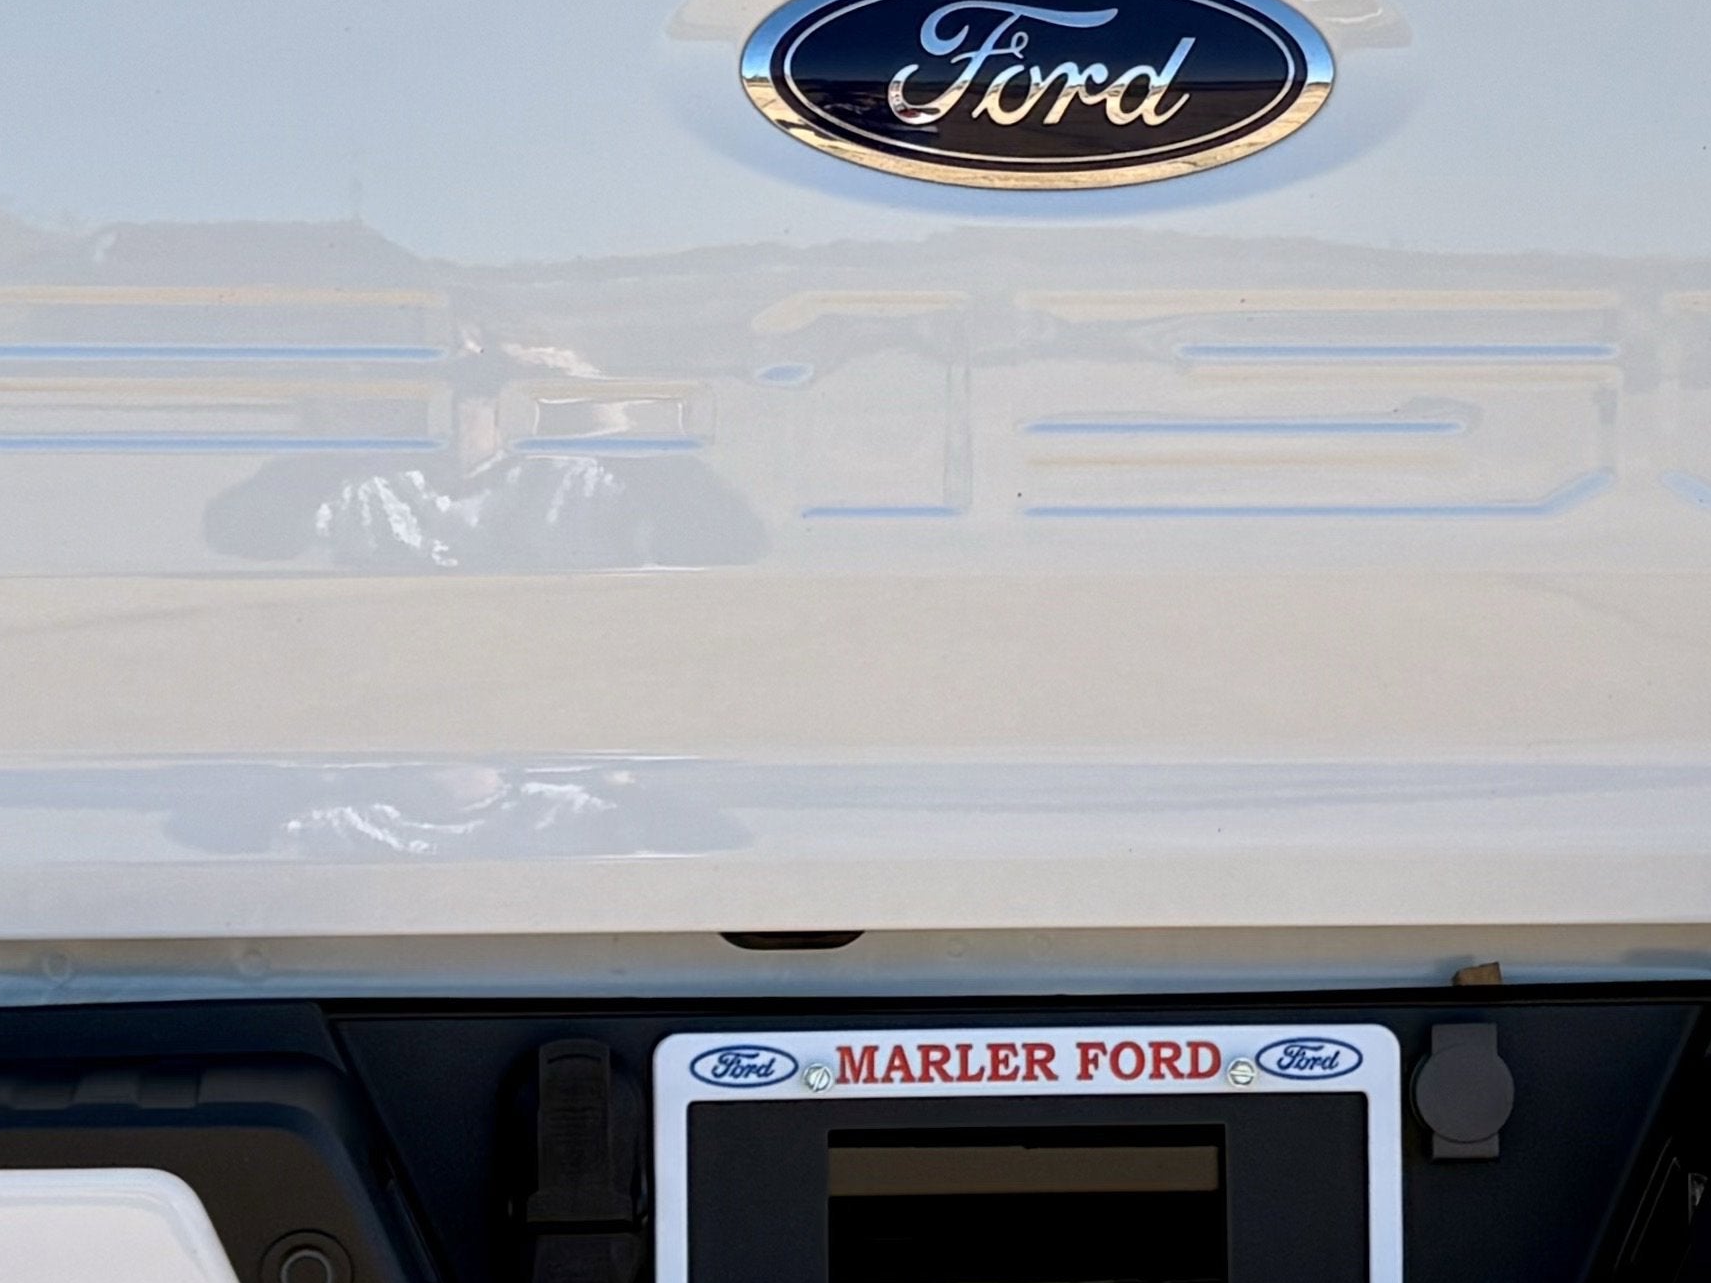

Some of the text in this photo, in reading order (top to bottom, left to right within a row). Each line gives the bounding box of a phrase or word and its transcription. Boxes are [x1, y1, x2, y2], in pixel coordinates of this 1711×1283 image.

[887, 0, 1196, 126] Ford
[710, 1051, 776, 1079] Ford
[835, 1040, 1222, 1085] MARLER FORD
[1276, 1044, 1340, 1071] Ford
